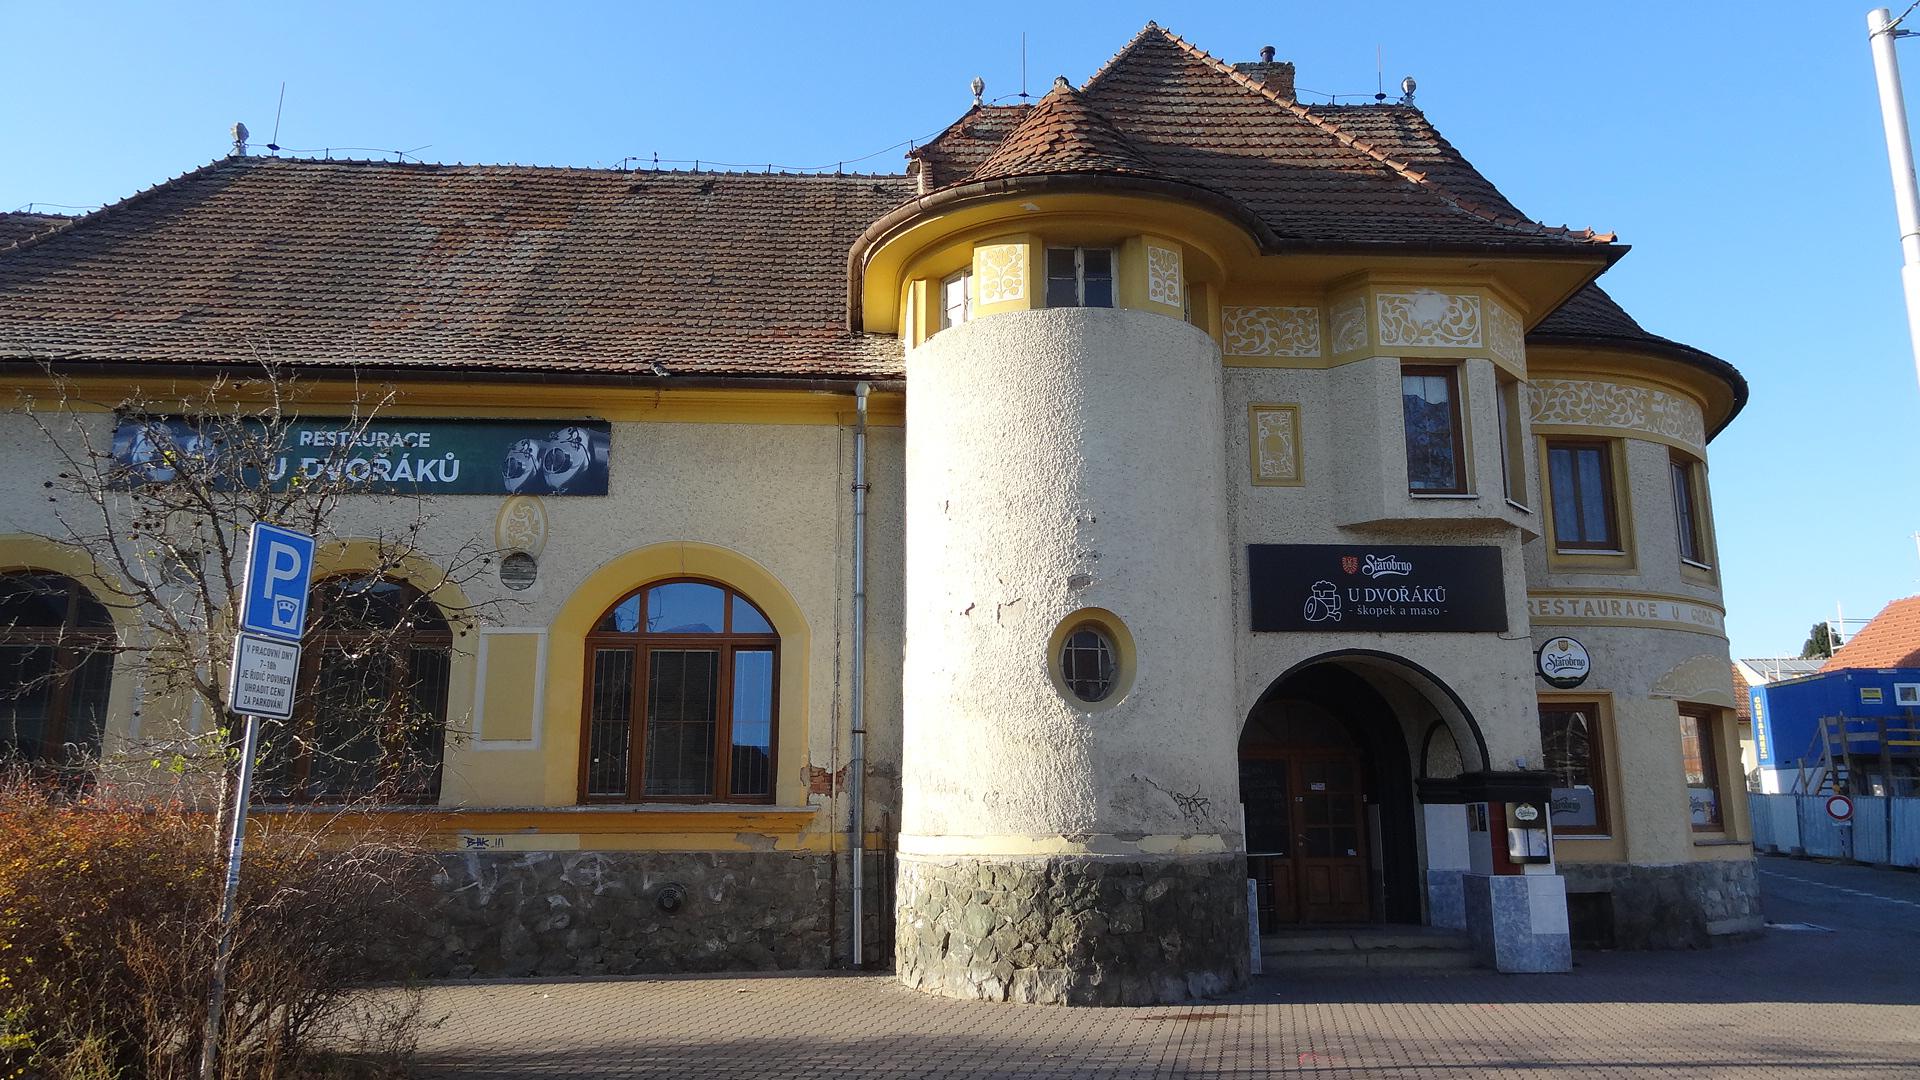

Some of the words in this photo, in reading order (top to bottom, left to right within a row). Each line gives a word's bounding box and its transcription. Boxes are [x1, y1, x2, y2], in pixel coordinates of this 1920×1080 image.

[299, 430, 431, 448] RESTAURACE
[268, 457, 287, 481] U
[264, 540, 302, 600] P
[1362, 554, 1412, 579] Starobrno
[1348, 588, 1360, 602] U
[1364, 585, 1446, 602] DVOŘÁKŮ
[1357, 604, 1396, 617] škopek
[1400, 607, 1406, 615] a
[1410, 607, 1440, 615] maso
[1527, 599, 1658, 618] RESTAURACE
[246, 644, 250, 653] V
[251, 645, 281, 659] PRACOVNÍ
[281, 650, 294, 660] DNY
[1545, 653, 1586, 673] Starobrno
[241, 669, 249, 679] JE
[250, 668, 266, 681] ŘIDIČ
[266, 673, 291, 685] POVINEN
[244, 683, 270, 695] UHRADIT
[270, 686, 286, 697] CENU
[243, 695, 251, 705] ZA
